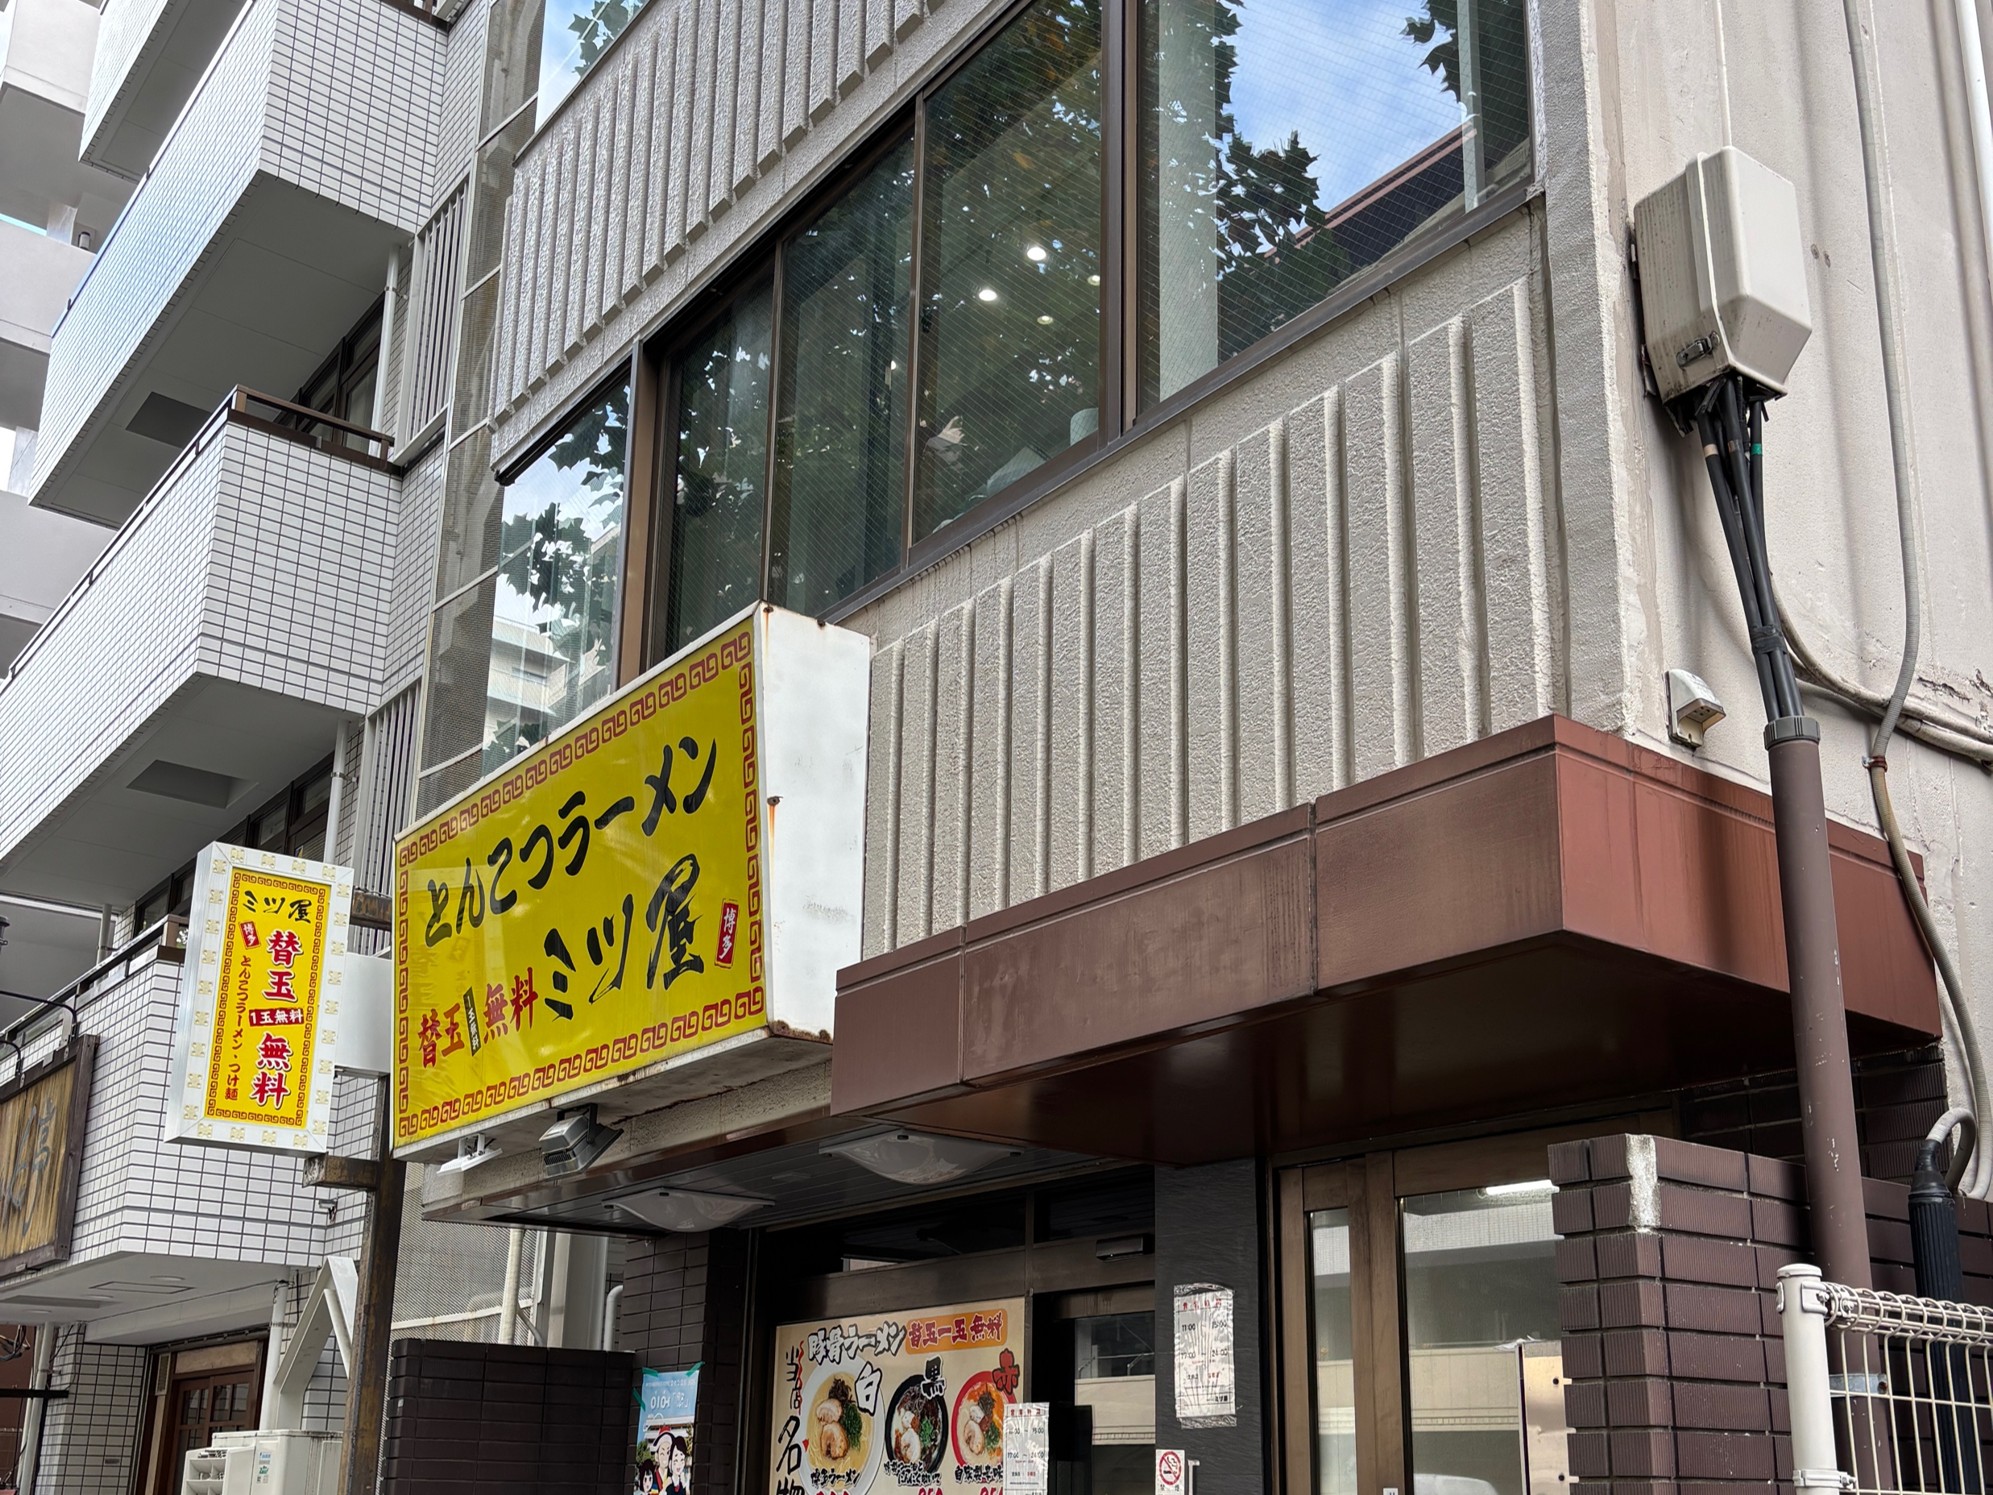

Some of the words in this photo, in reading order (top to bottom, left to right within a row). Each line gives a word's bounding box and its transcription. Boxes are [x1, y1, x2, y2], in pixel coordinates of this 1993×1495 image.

[424, 736, 718, 949] とんこつラーメン
[242, 890, 314, 925] ミツ屋
[719, 906, 737, 964] 博多
[543, 853, 706, 1021] ミツ屋
[263, 930, 304, 1003] 替玉
[250, 1009, 304, 1027] 1玉無料
[417, 999, 466, 1070] 替玉
[483, 967, 539, 1044] 無料
[250, 1033, 293, 1109] 無料
[807, 1321, 907, 1365] 豚骨ラーメン
[992, 1347, 1020, 1396] 赤
[855, 1361, 883, 1417] 白
[921, 1356, 948, 1398] 黒
